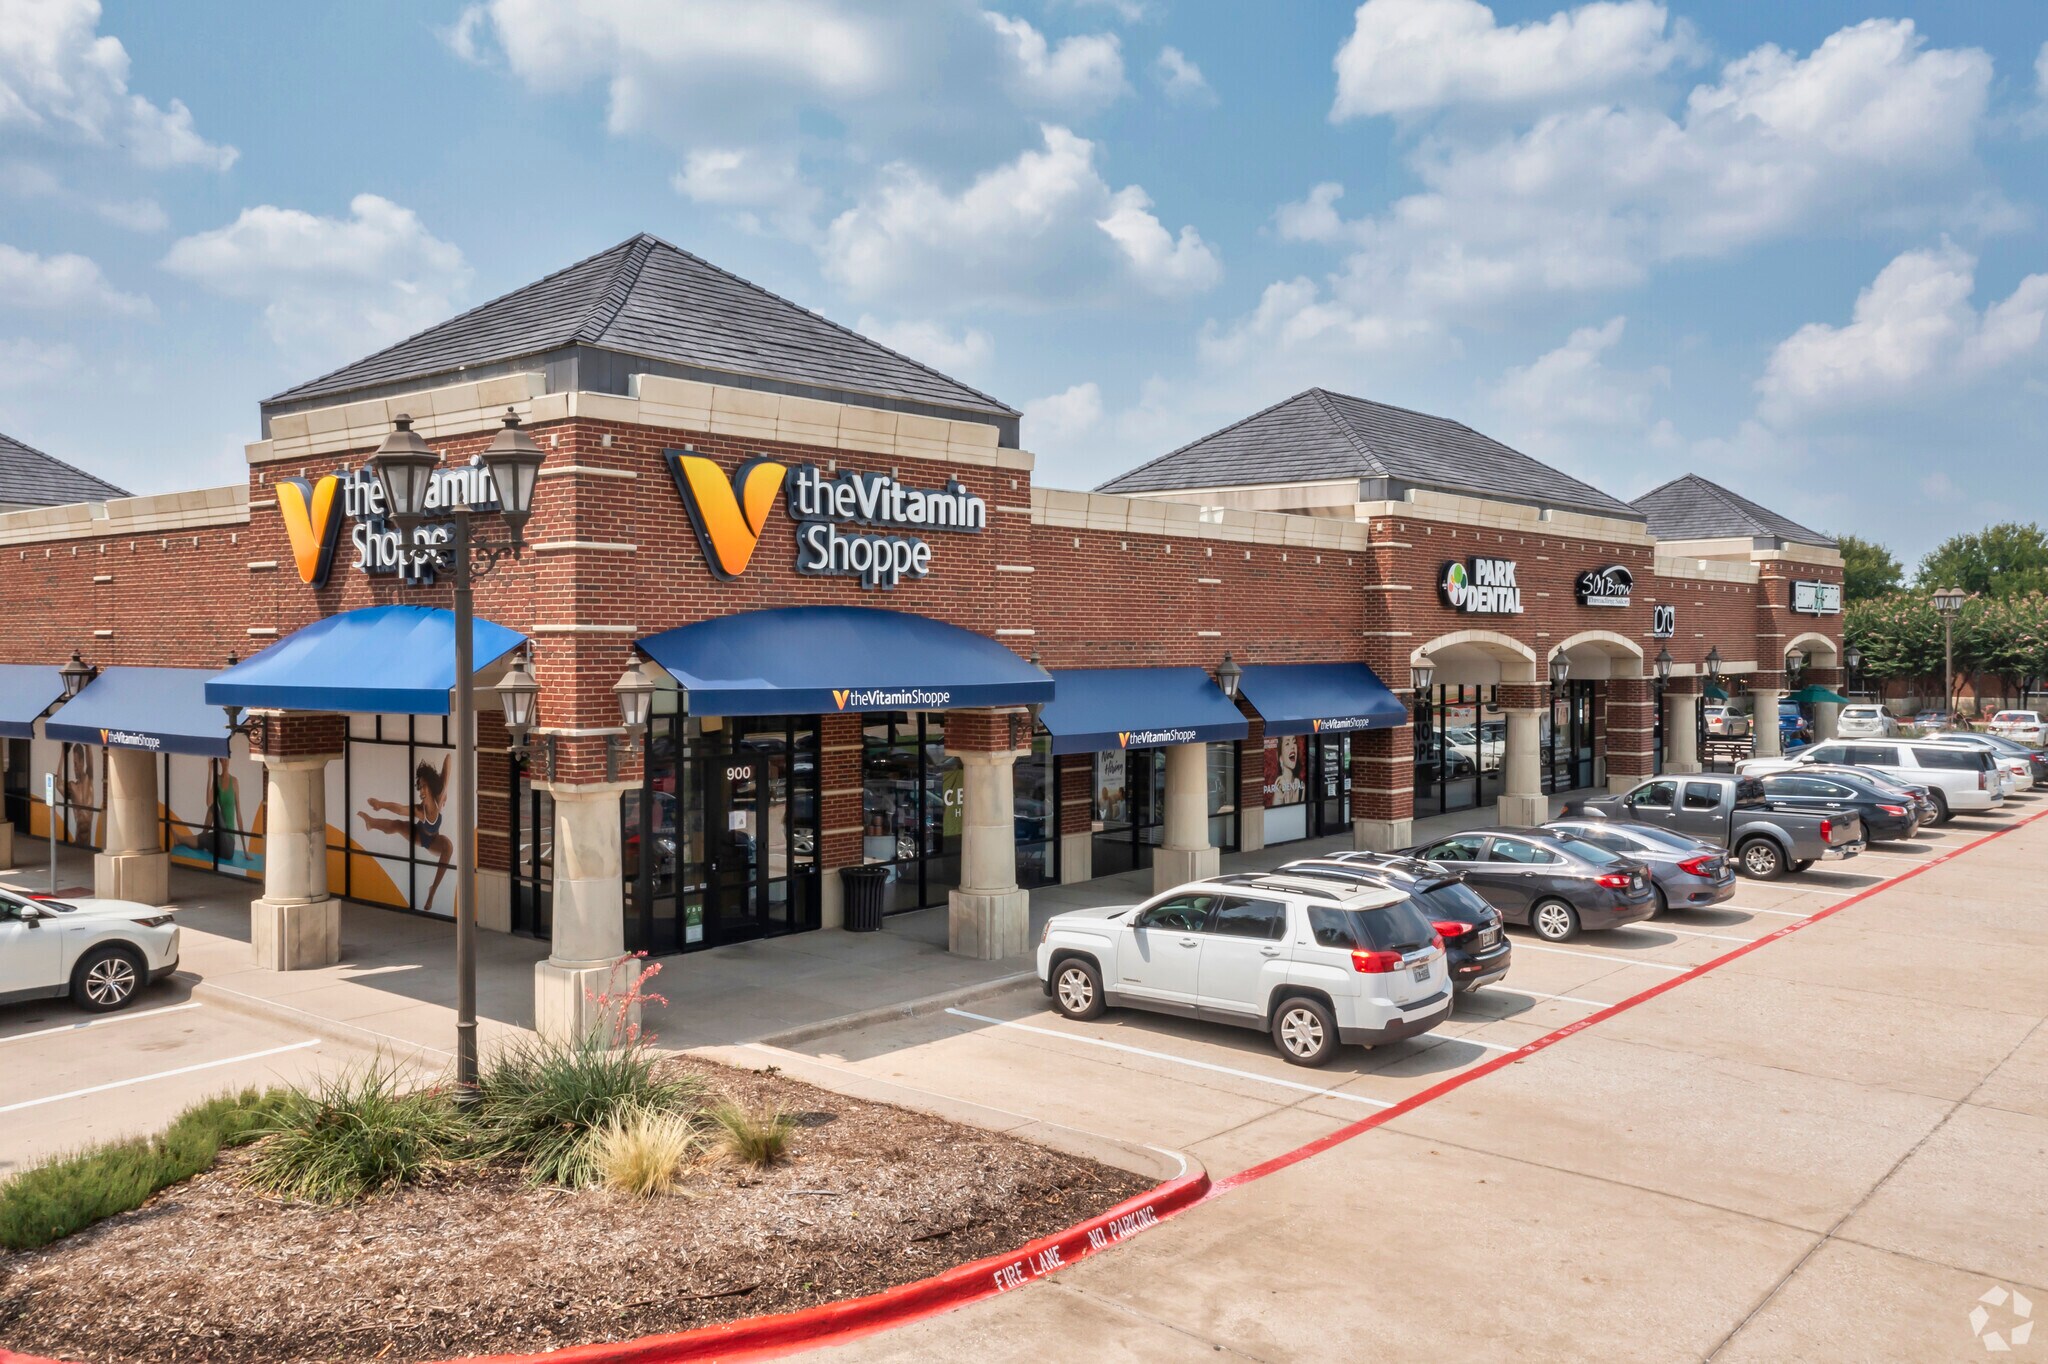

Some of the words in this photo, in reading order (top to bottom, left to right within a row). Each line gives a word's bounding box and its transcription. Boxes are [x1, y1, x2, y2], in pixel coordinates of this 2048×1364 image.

[343, 454, 498, 516] theamin
[797, 467, 986, 528] theVitamin
[807, 523, 931, 584] Shoppe
[1475, 559, 1517, 587] PARK
[1467, 585, 1524, 613] DENTAL
[850, 689, 950, 707] theVitaminShoppe
[1321, 718, 1369, 731] theVitaminShoppe
[108, 731, 160, 750] theVitaminShoppe
[1129, 729, 1197, 745] theVitaminShoppe
[1101, 750, 1116, 762] Now
[726, 766, 751, 780] 900
[1105, 761, 1124, 776] Hiring
[1263, 784, 1279, 794] PARK
[1283, 780, 1305, 792] DENTAL
[993, 1261, 1028, 1291] FIRE
[1028, 1245, 1065, 1276] LANE
[1087, 1227, 1107, 1250] NO
[1109, 1205, 1159, 1241] PARKING
